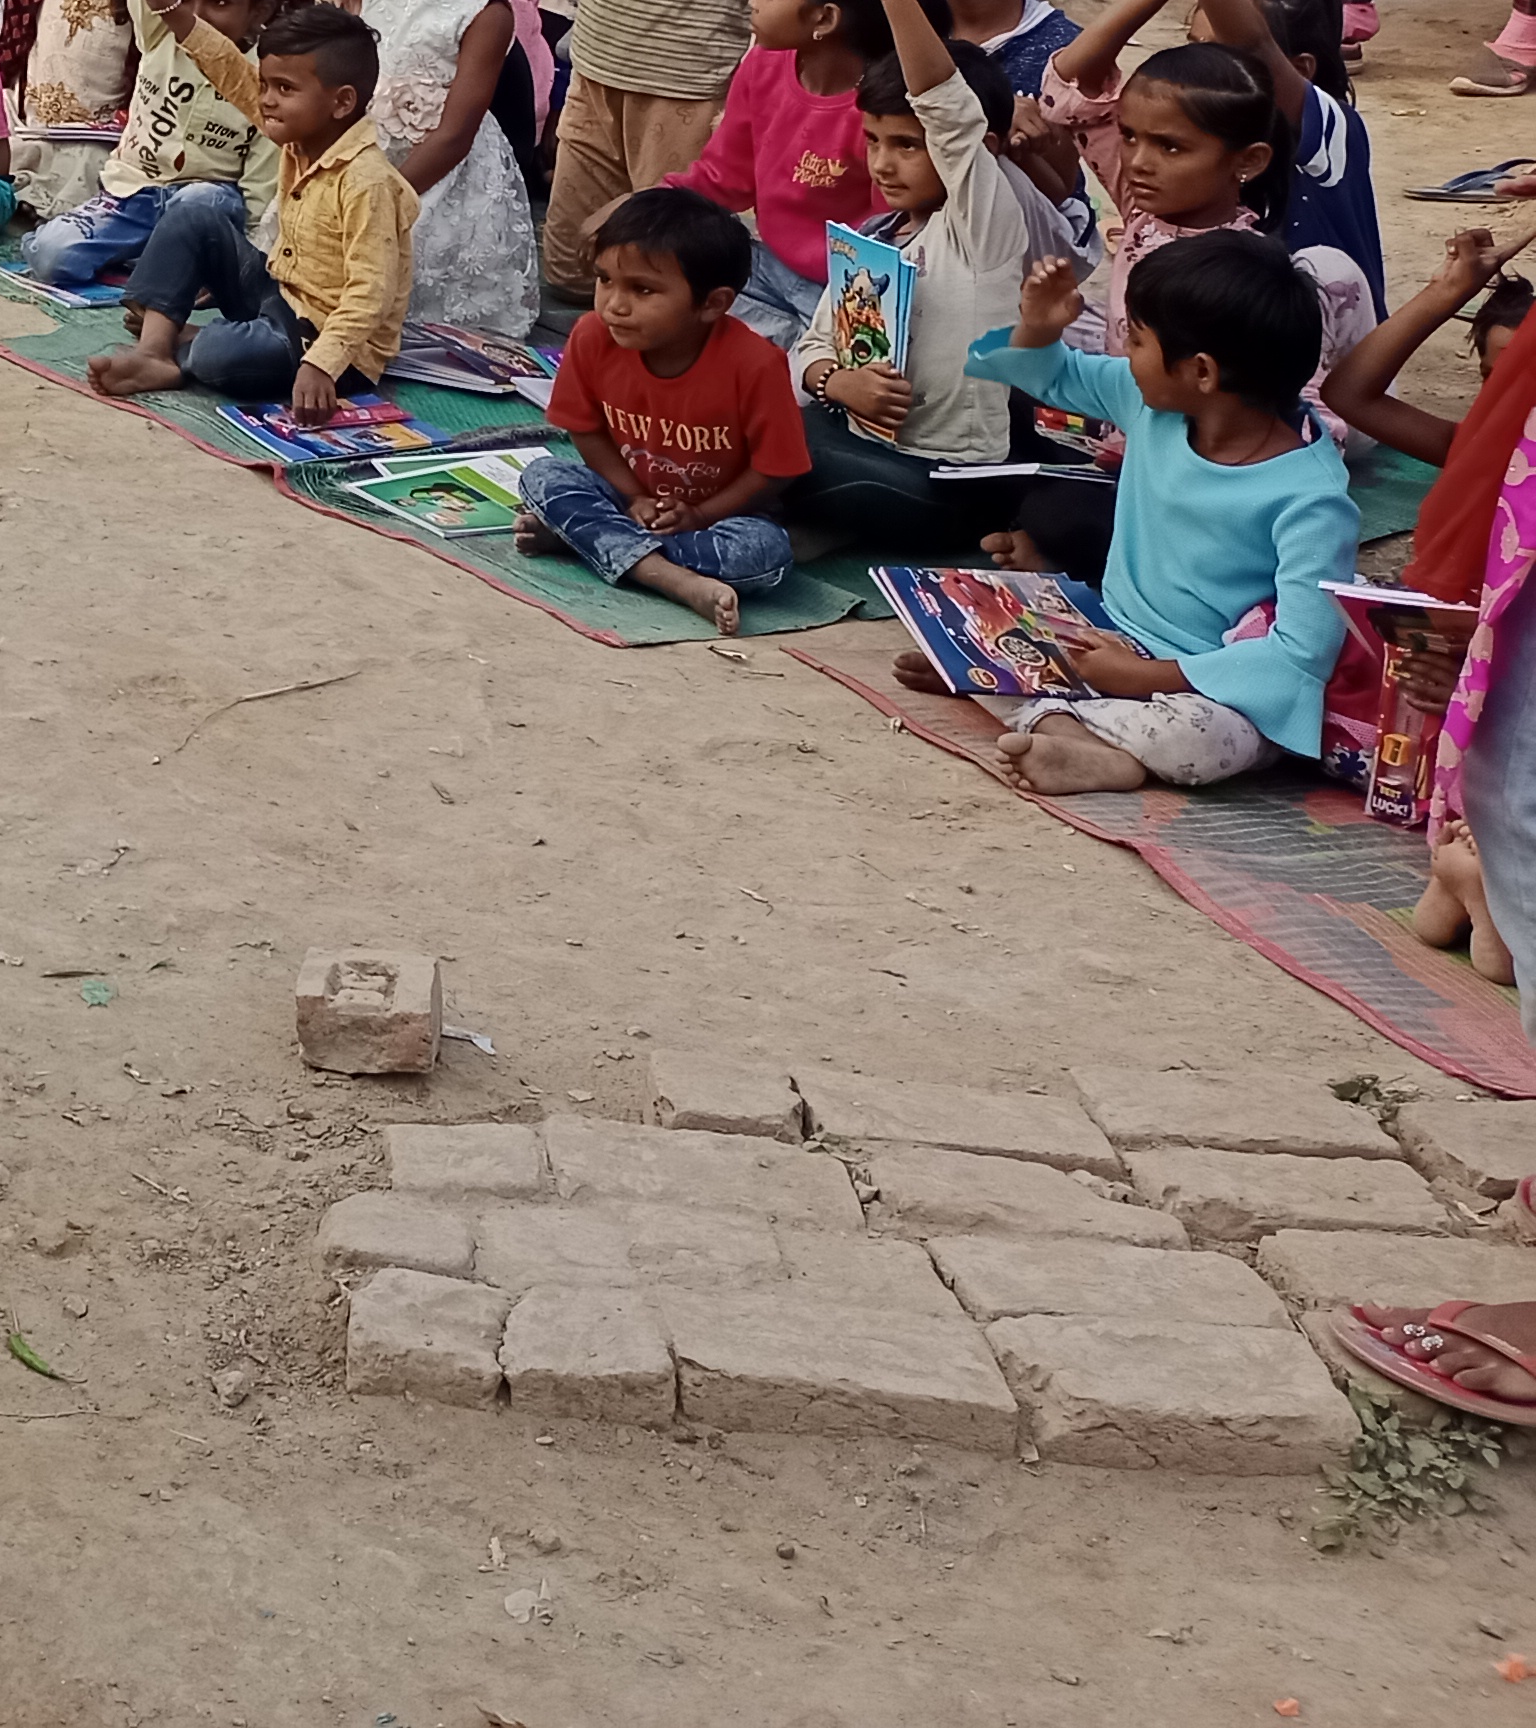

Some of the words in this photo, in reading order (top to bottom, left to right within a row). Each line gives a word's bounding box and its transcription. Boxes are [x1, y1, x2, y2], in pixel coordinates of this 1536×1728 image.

[602, 400, 652, 441] NEW
[659, 418, 732, 453] YORK
[1372, 796, 1408, 816] LUCK!
